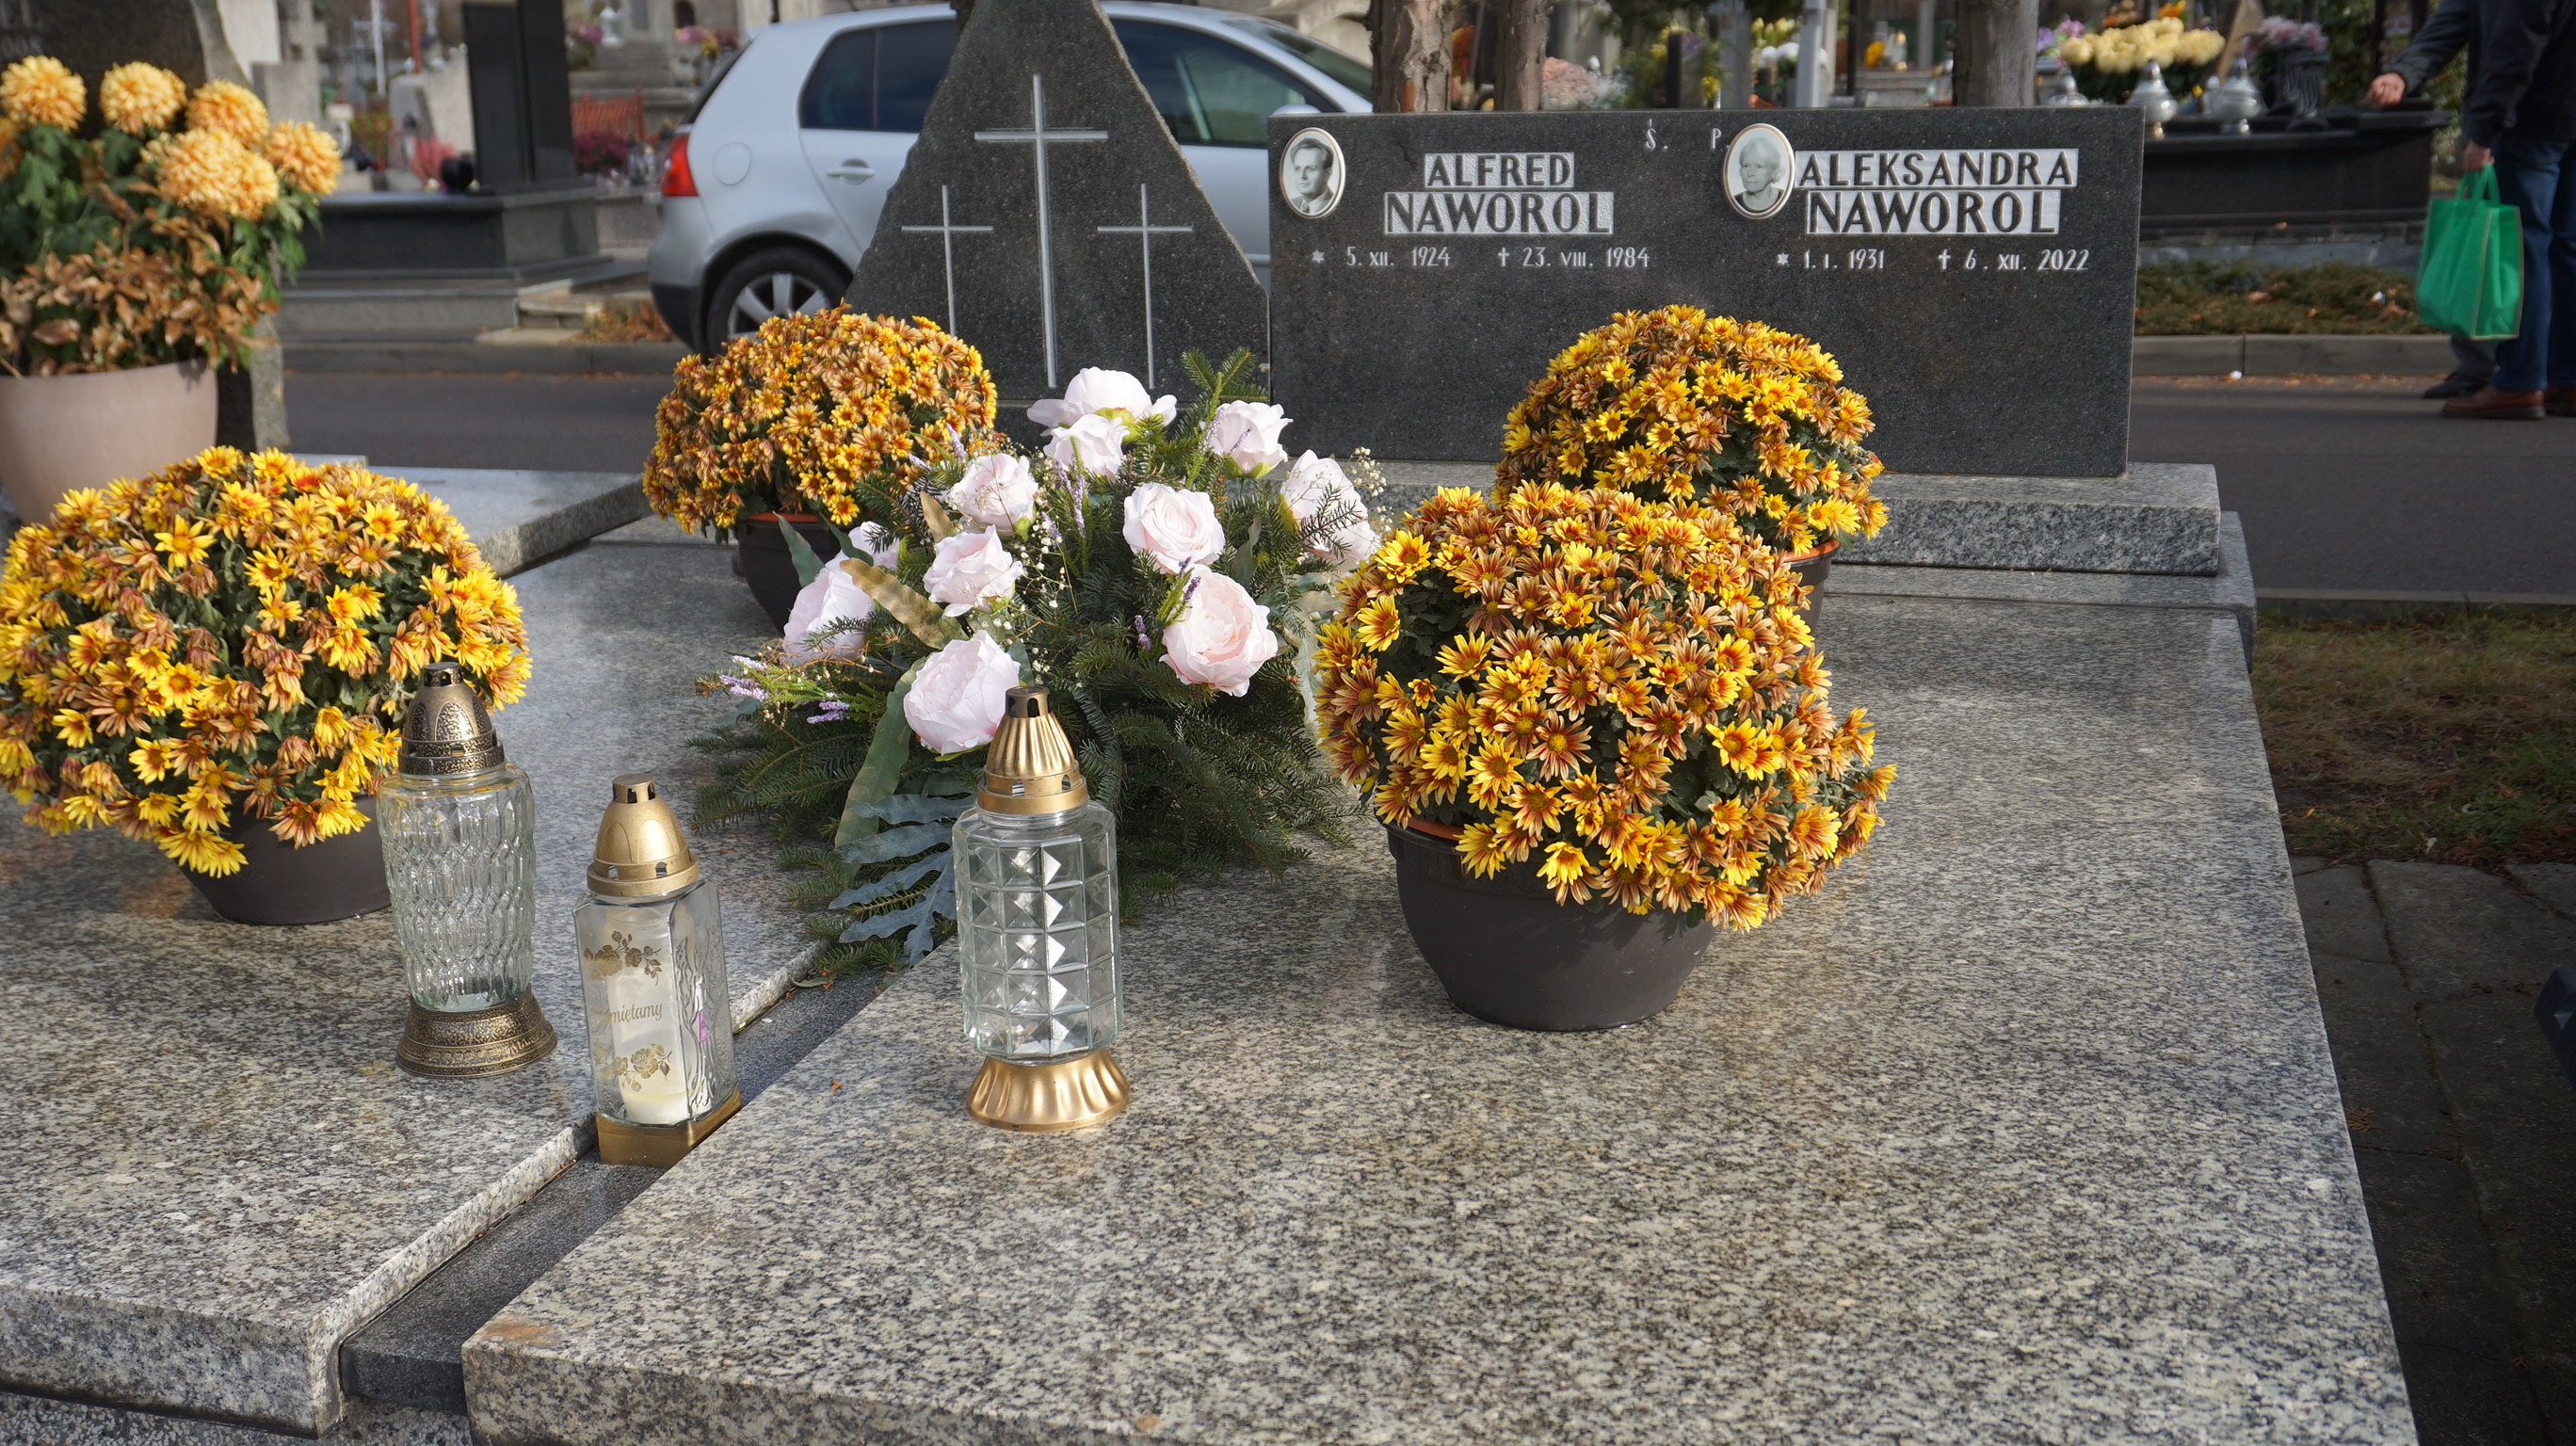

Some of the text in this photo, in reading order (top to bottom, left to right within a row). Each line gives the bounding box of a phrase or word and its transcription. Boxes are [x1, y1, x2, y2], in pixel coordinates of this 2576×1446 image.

[1426, 153, 1571, 186] ALFRED
[1798, 152, 2074, 186] ALEKSANDRA
[1387, 192, 1611, 233] NAWOROL
[1809, 191, 2056, 233] NAWOROL
[1346, 246, 1362, 266] 5.
[1412, 246, 1451, 266] 1924
[1522, 247, 1552, 267] 23.
[1606, 247, 1650, 267] 1984
[1849, 249, 1884, 269] 1931
[2038, 249, 2089, 270] 2022
